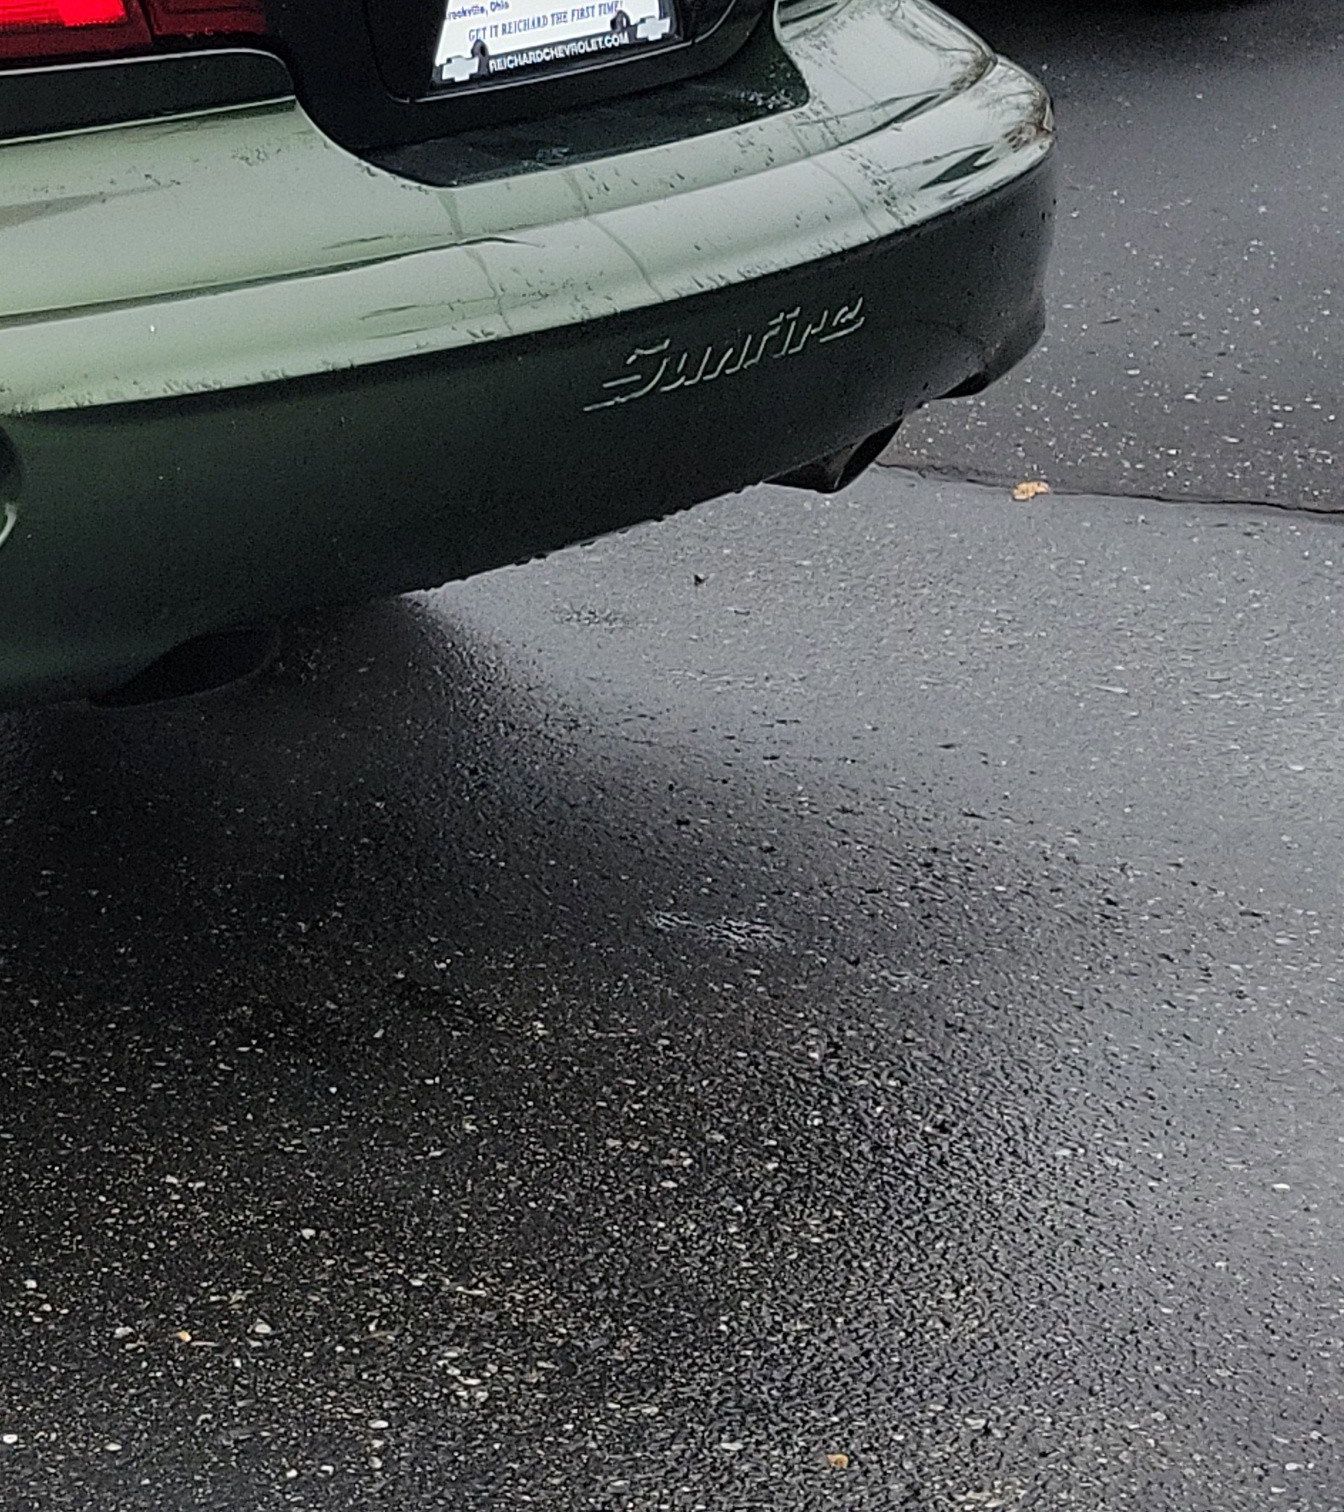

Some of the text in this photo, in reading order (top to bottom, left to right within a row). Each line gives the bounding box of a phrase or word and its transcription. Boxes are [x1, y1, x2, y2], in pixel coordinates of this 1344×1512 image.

[468, 27, 487, 41] GET
[489, 24, 500, 38] IT
[501, 14, 548, 37] REICHARD
[551, 11, 568, 26] THE
[571, 4, 596, 22] FIRST
[489, 32, 630, 73] REICHARDCHEVROLET.COM
[583, 296, 865, 412] Sunfire
